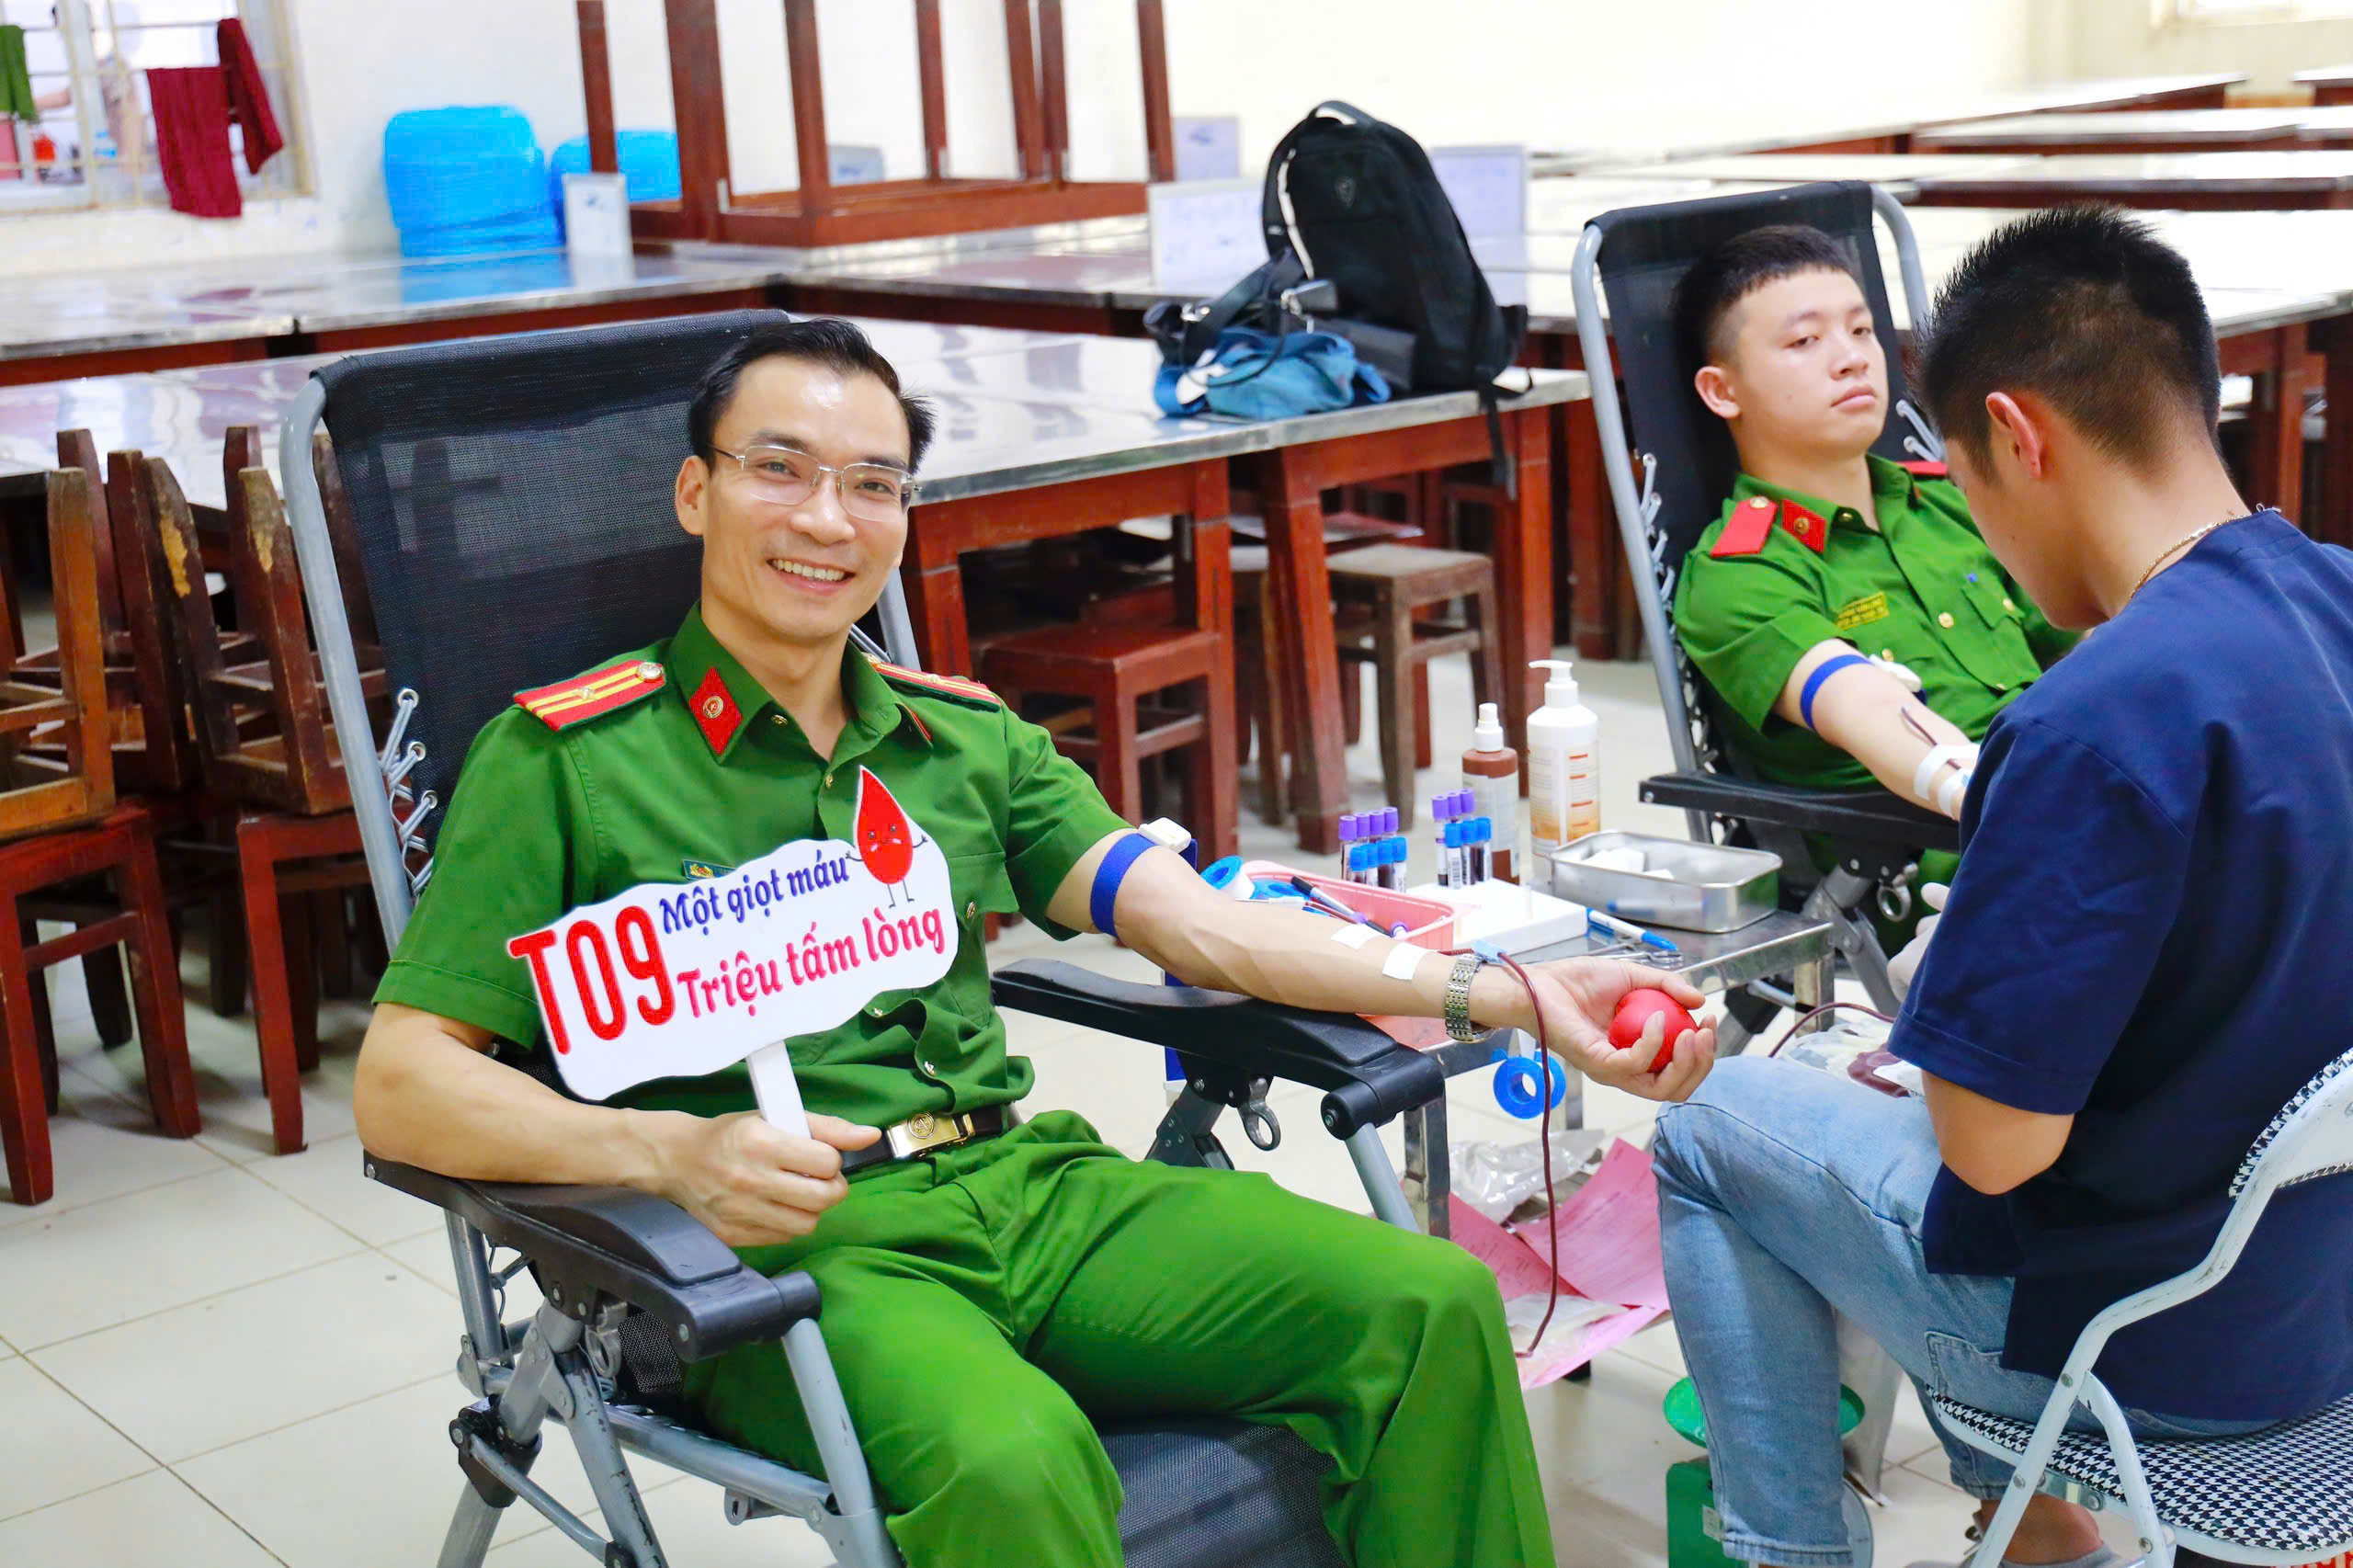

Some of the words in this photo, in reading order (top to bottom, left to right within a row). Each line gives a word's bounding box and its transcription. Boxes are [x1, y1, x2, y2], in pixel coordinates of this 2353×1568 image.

[659, 886, 723, 935] Một
[728, 874, 783, 919] giọt
[787, 849, 849, 897] máu
[508, 905, 676, 1055] T09
[676, 949, 783, 1017] Triệu
[786, 922, 861, 986] tấm
[861, 906, 946, 962] lòng
